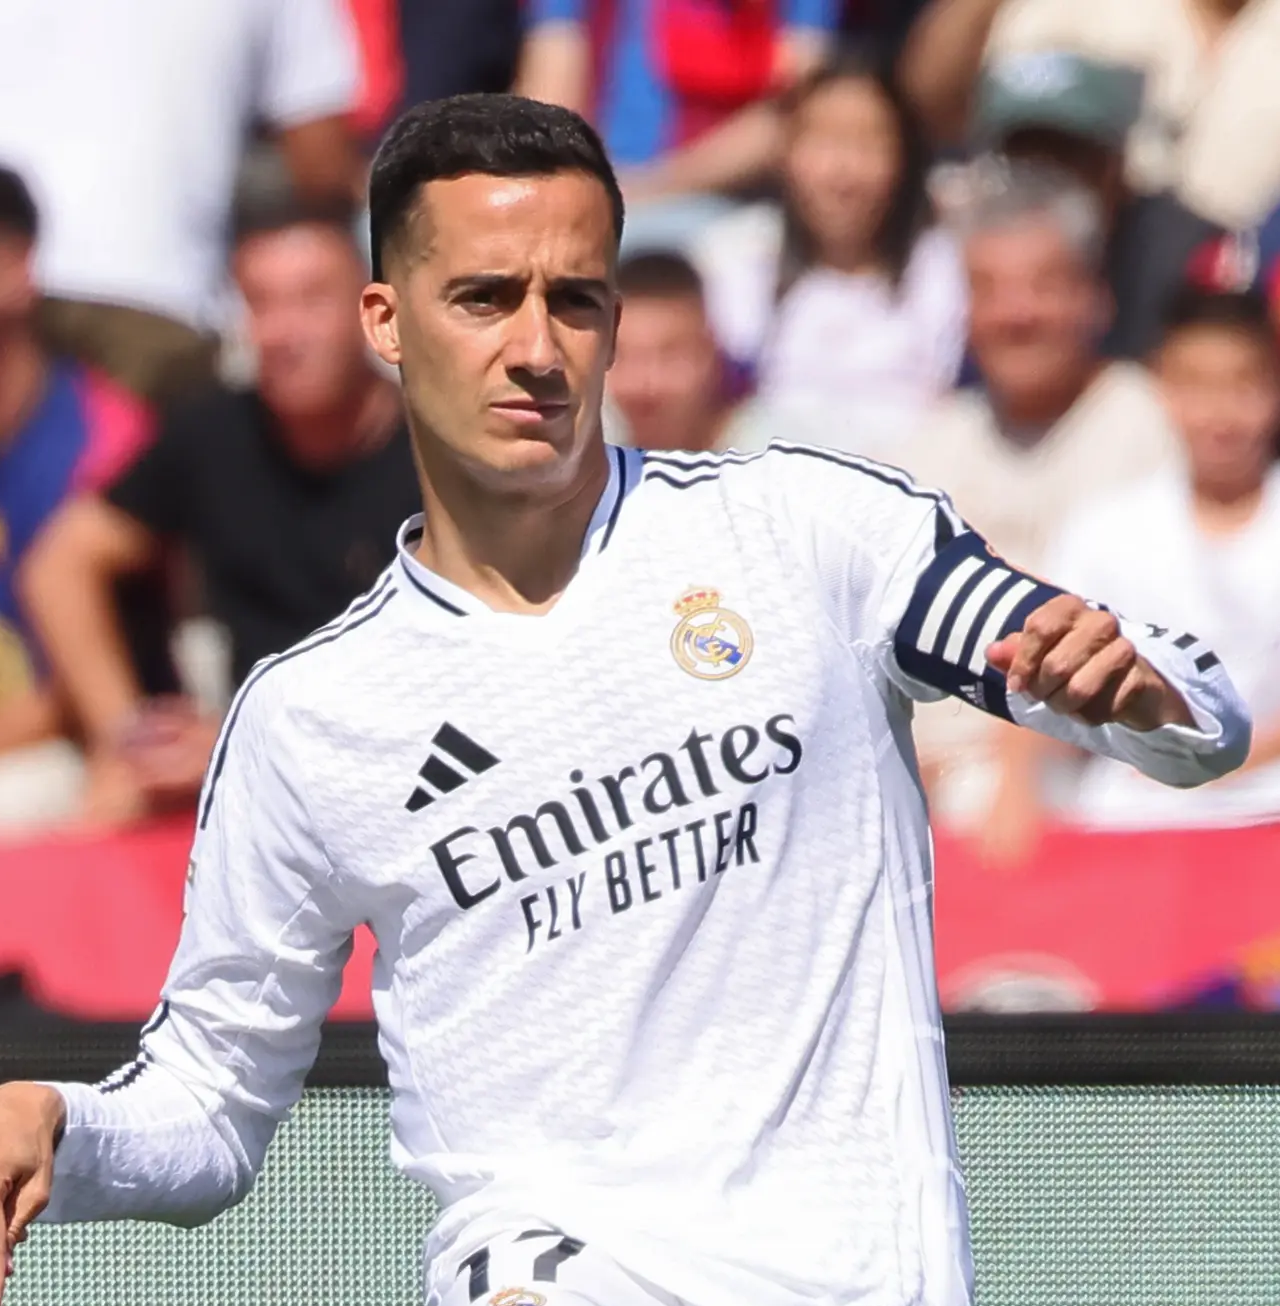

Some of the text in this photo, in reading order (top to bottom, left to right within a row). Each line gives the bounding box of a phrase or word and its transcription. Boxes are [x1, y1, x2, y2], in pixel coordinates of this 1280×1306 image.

[428, 712, 803, 911] Emirates
[520, 801, 762, 953] FLY BETTER
[455, 1228, 588, 1304] 17
